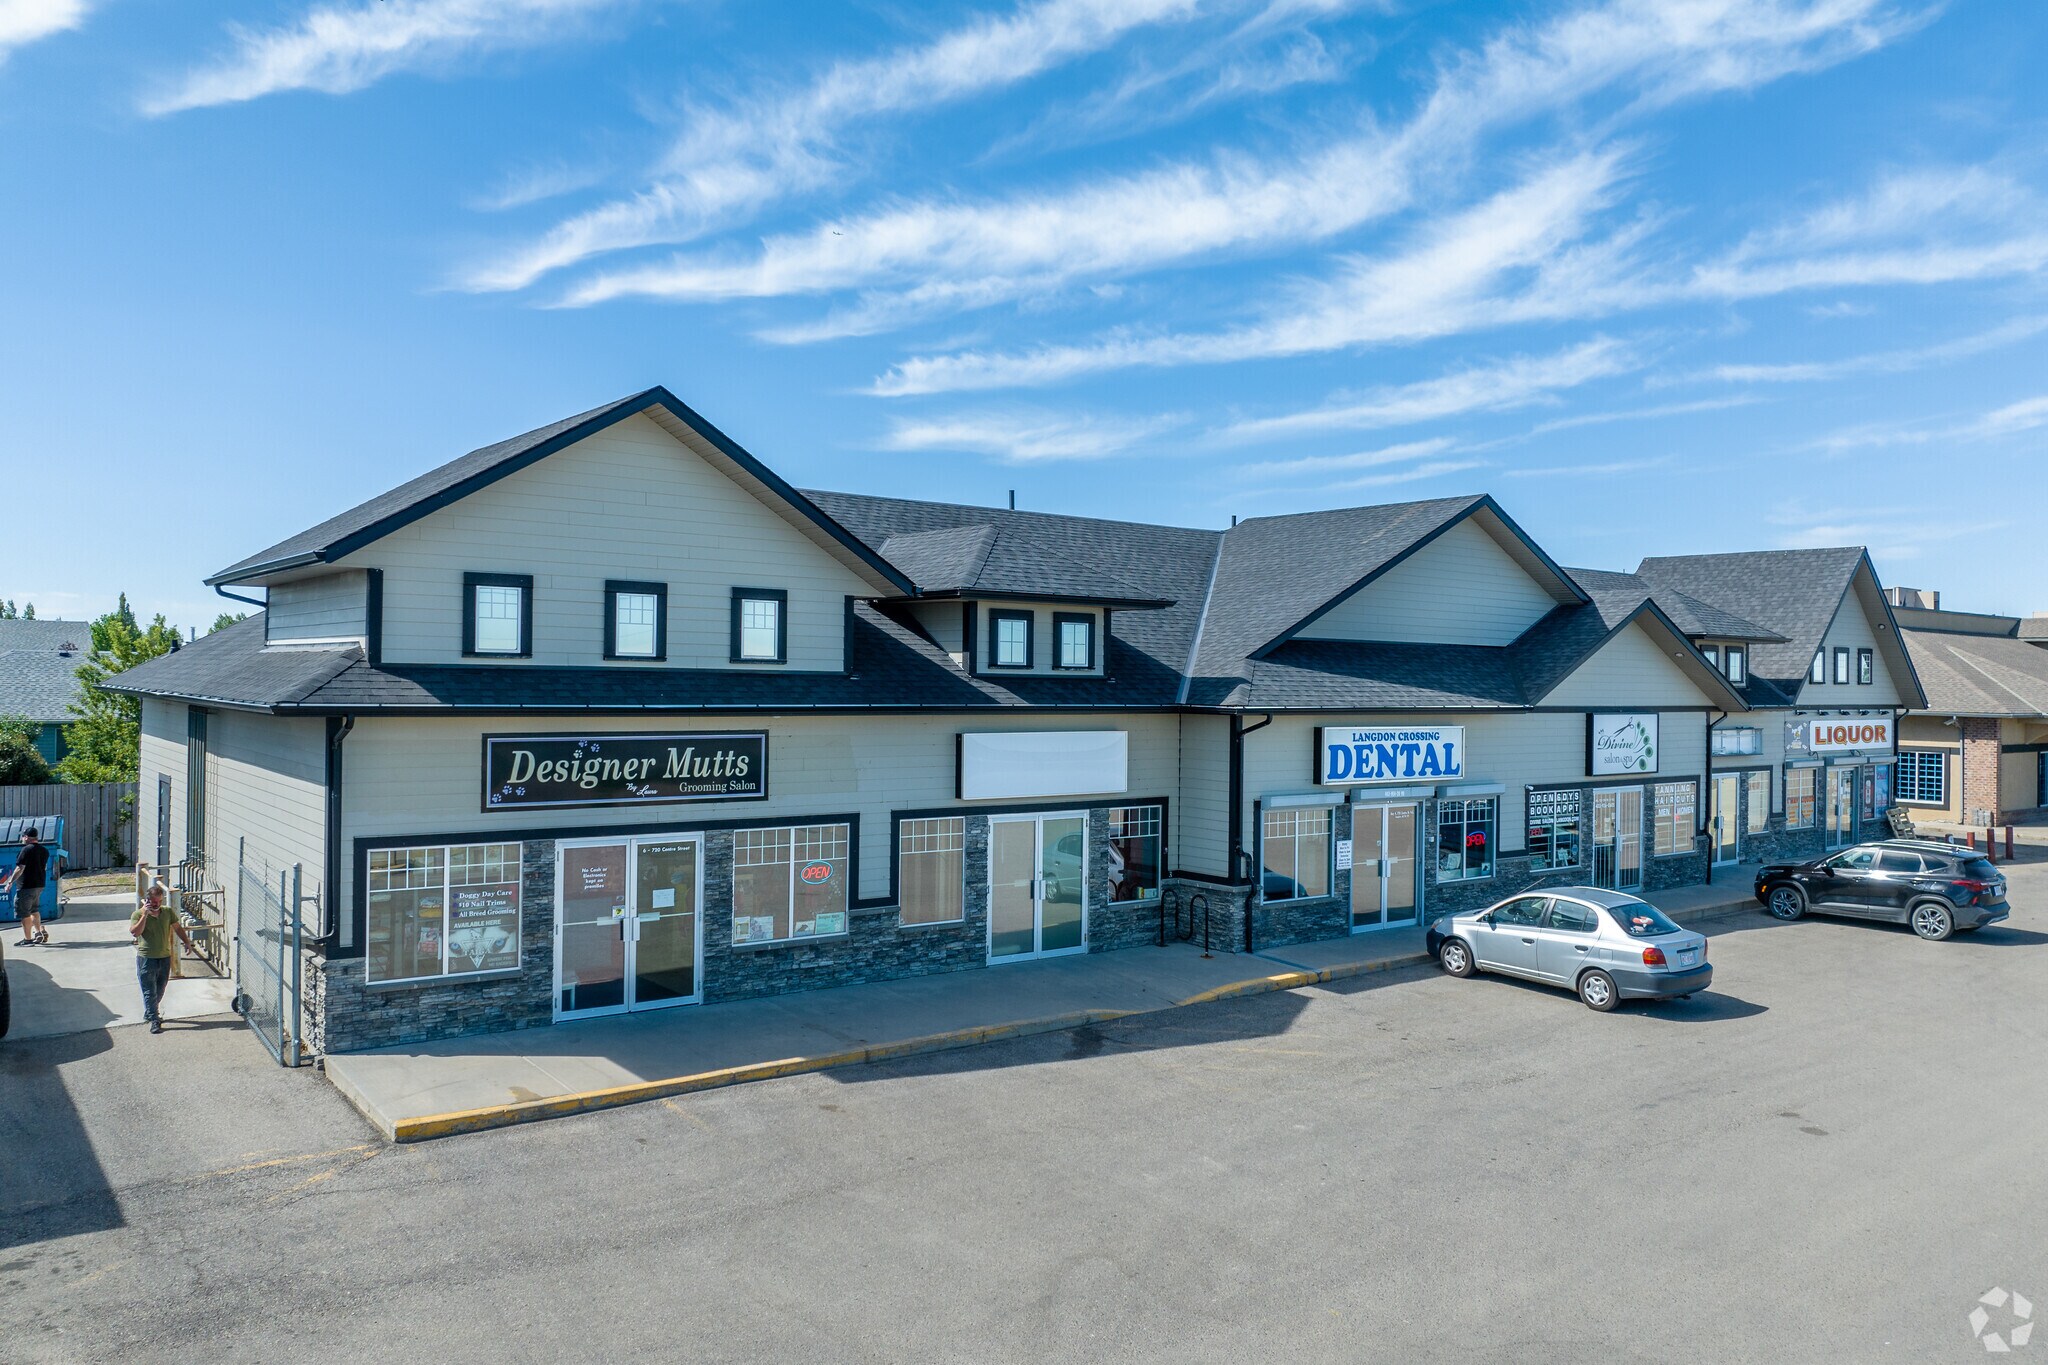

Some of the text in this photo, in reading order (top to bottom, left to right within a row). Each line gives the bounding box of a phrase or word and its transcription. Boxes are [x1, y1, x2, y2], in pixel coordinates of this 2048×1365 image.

[1352, 732, 1440, 742] LANGDON CROSSING
[1815, 725, 1887, 745] LIQUOR
[1597, 735, 1634, 750] Divine
[1327, 743, 1460, 780] DENTAL
[506, 747, 749, 789] Designer Mutts
[626, 783, 638, 792] By
[679, 780, 756, 793] Grooming Salon
[1655, 784, 1690, 793] TANNING
[1530, 793, 1554, 803] OPEN
[1530, 804, 1579, 815] BOOK APPT
[1466, 834, 1485, 846] OPEN
[802, 866, 830, 879] OPEN
[454, 920, 484, 929] AVAILABLE
